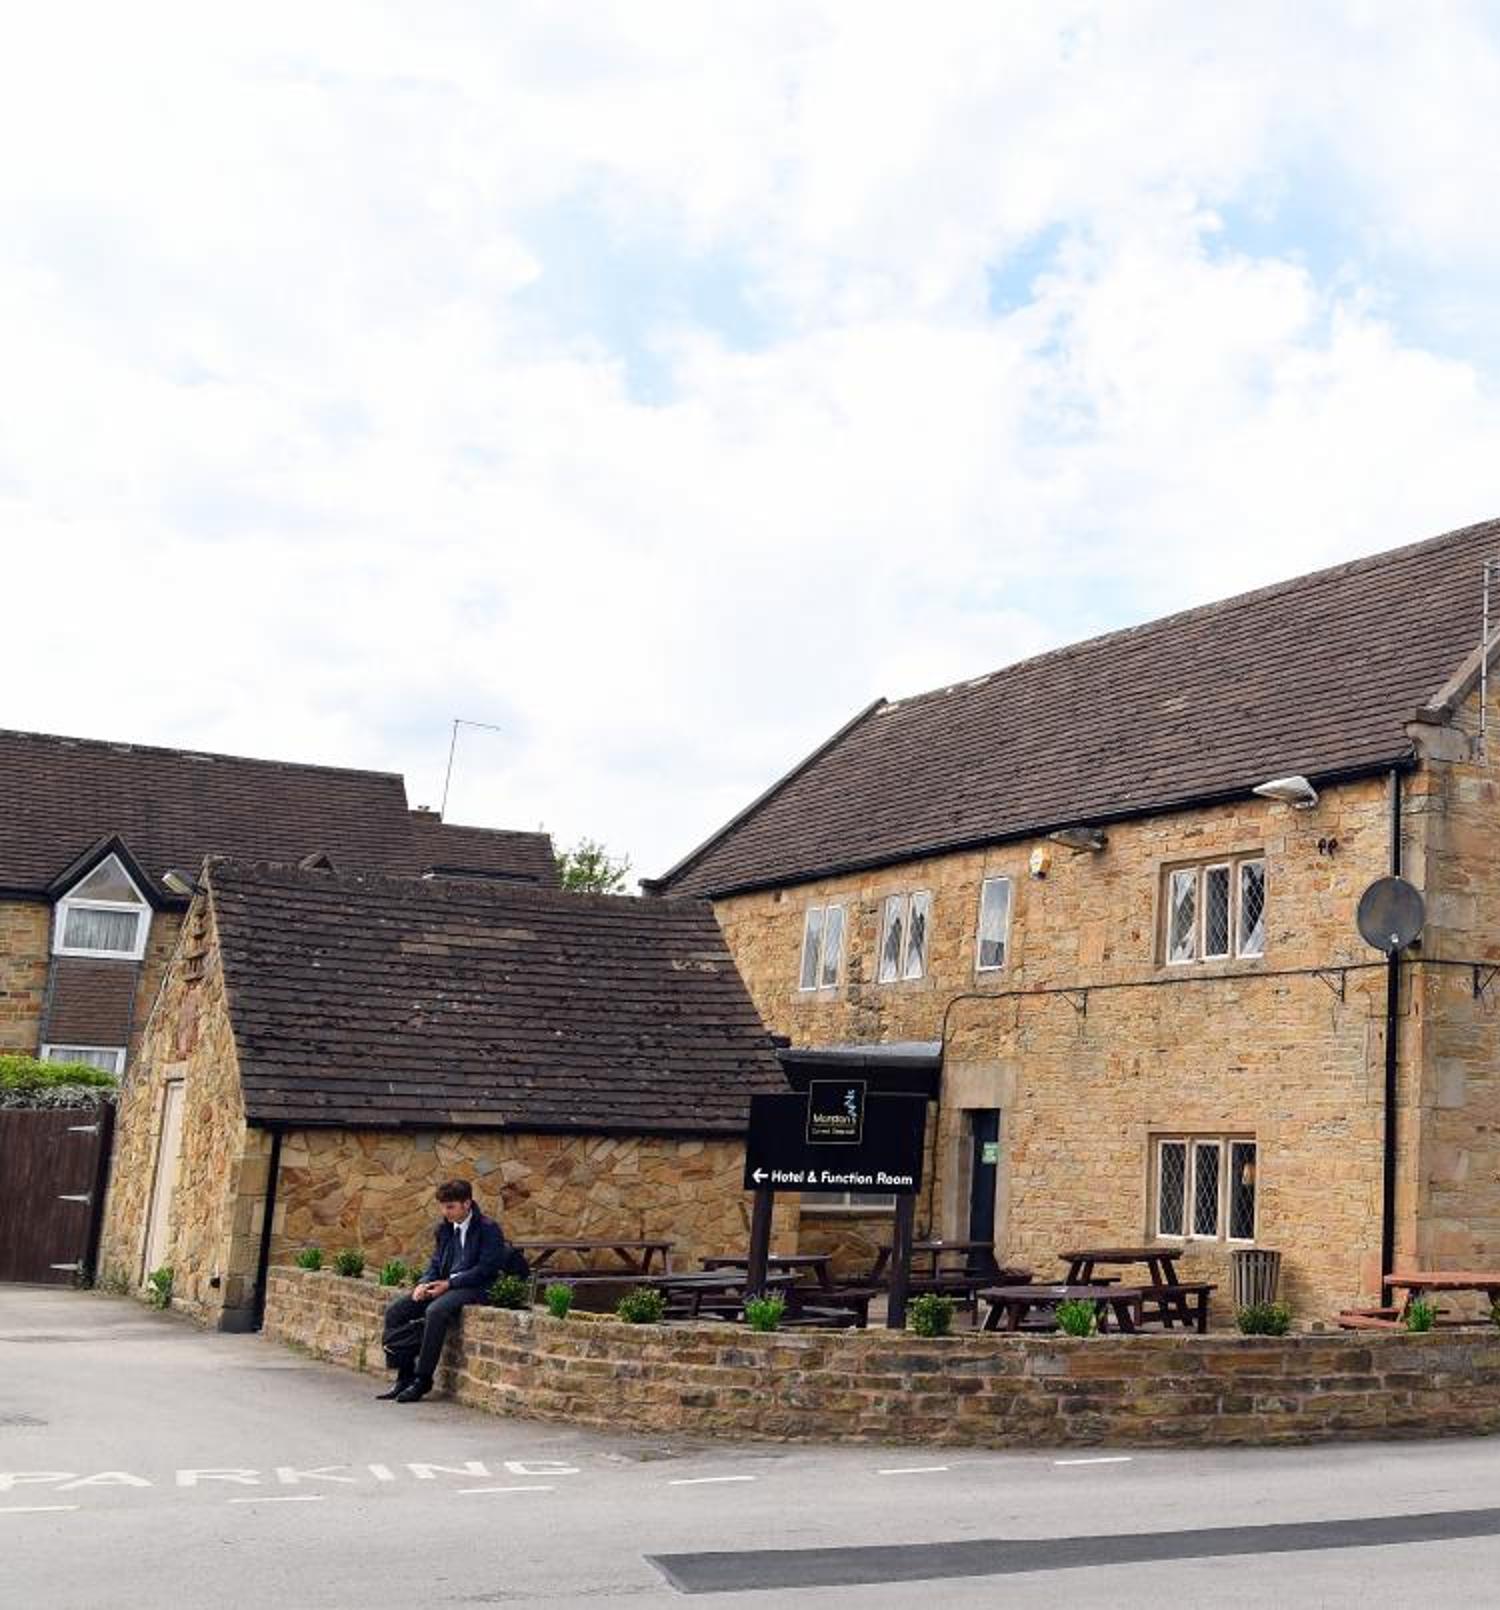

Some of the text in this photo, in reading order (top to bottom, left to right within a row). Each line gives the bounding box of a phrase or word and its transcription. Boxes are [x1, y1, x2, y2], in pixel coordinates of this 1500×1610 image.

[771, 1170, 913, 1186] Hotel & Function Room
[0, 1460, 580, 1491] PARKING
